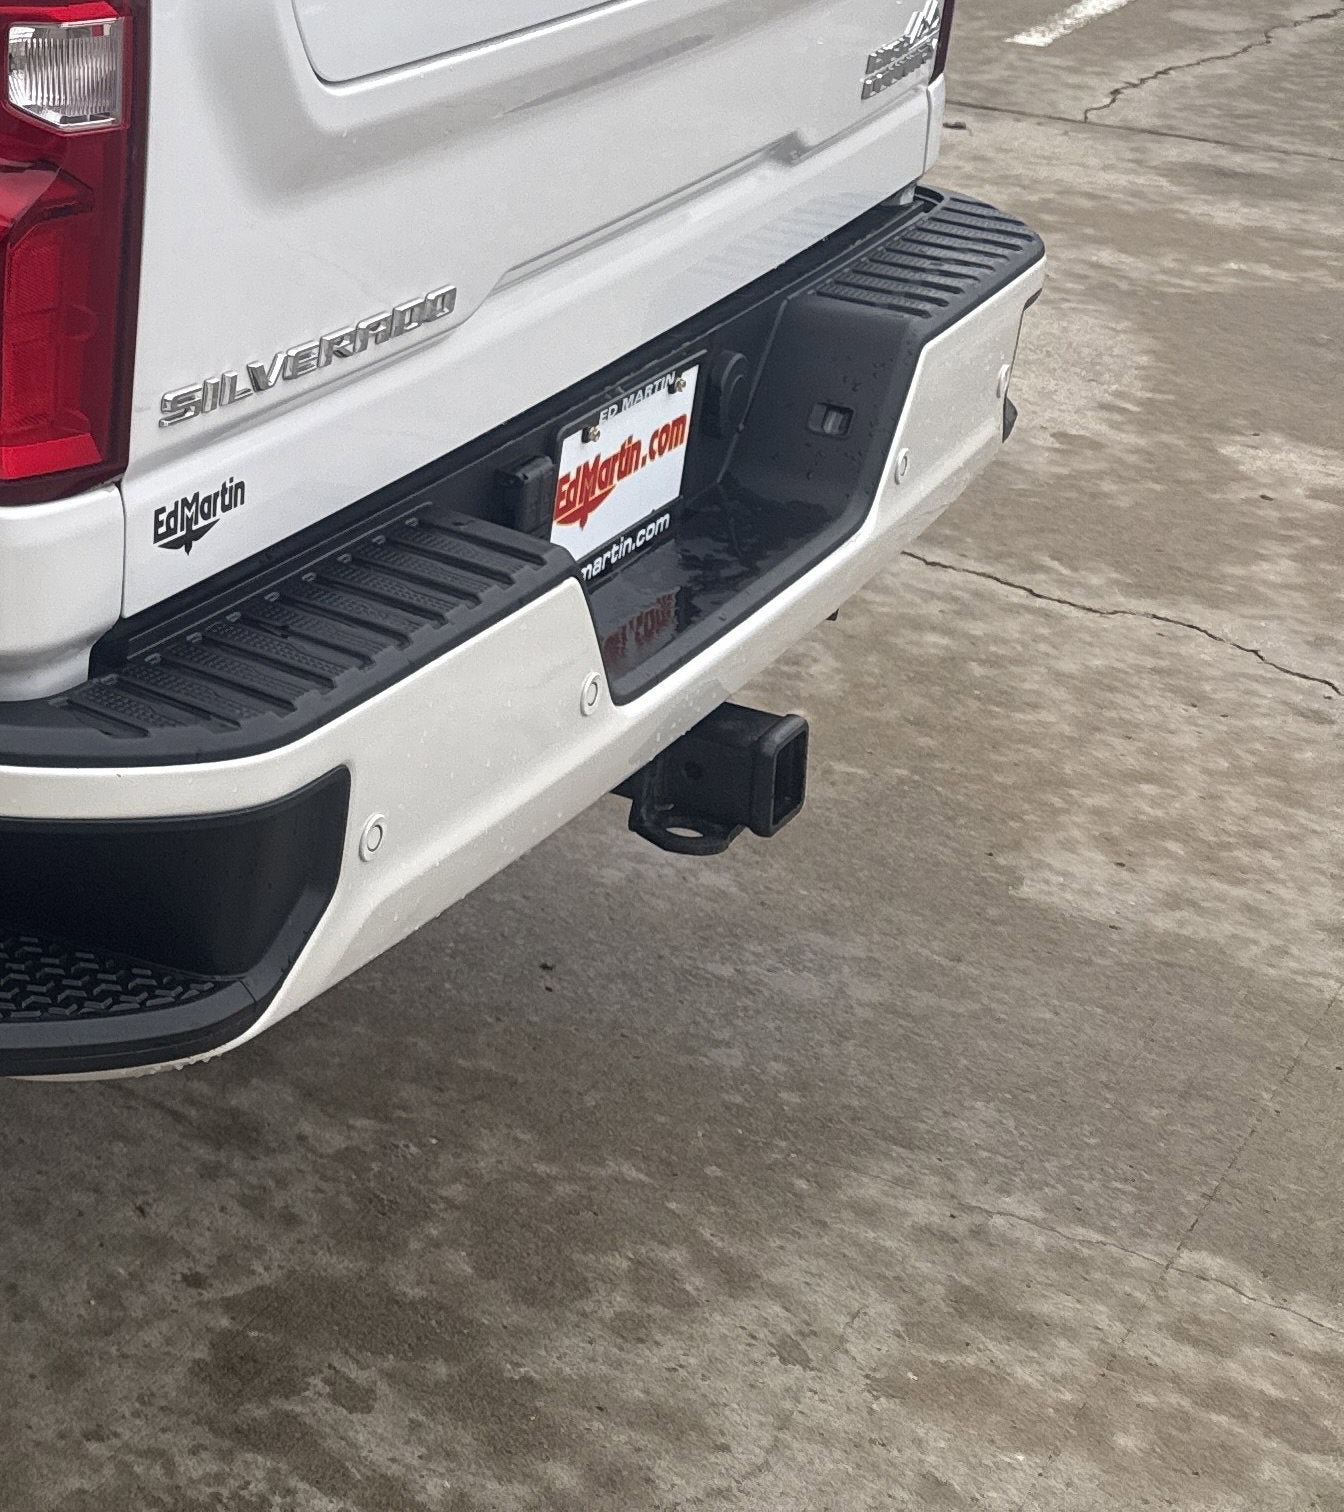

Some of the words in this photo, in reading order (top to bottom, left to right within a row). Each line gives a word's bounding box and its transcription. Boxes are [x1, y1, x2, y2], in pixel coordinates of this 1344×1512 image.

[158, 283, 458, 428] SILVERADO
[599, 404, 619, 422] ED
[621, 370, 677, 413] MARTIN
[553, 413, 688, 528] EdMartin.com
